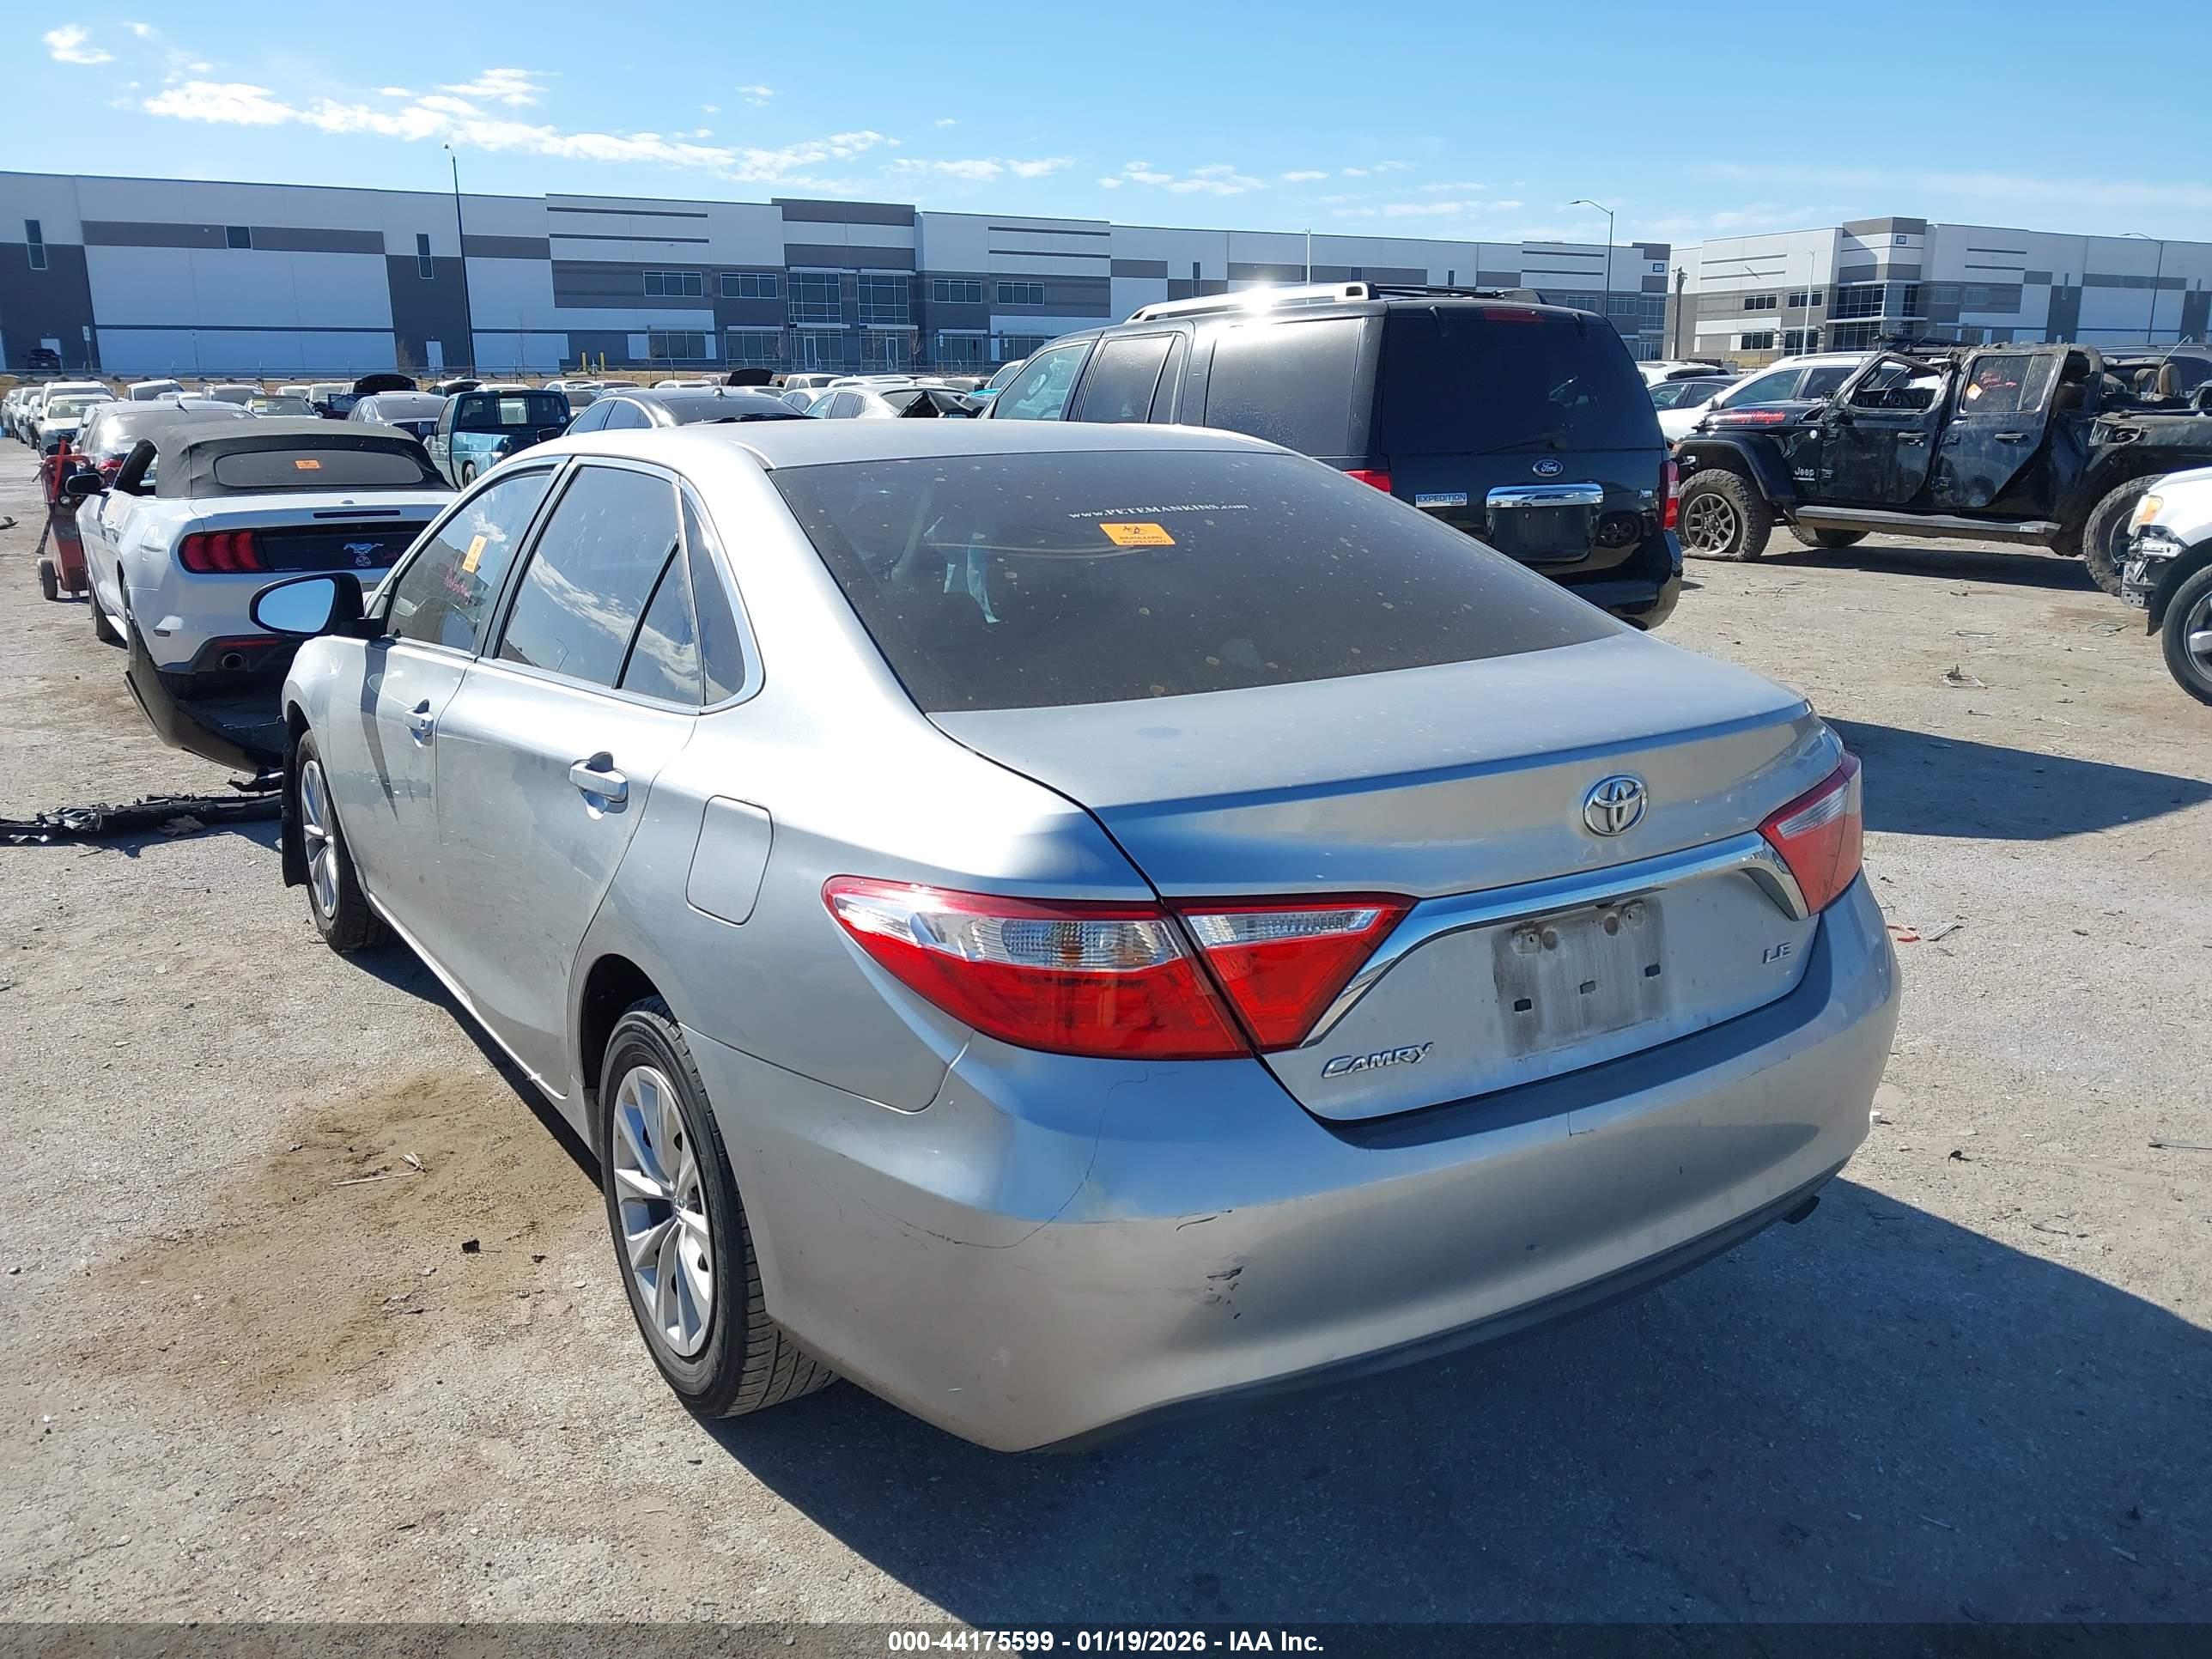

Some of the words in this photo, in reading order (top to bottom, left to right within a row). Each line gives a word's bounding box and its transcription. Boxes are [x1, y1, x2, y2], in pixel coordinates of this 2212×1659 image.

[1540, 462, 1558, 472] Ford
[1794, 466, 1814, 477] Jeep
[1417, 494, 1466, 502] EXPEDITION
[1762, 941, 1792, 964] LE
[1321, 1042, 1434, 1079] CAMRY
